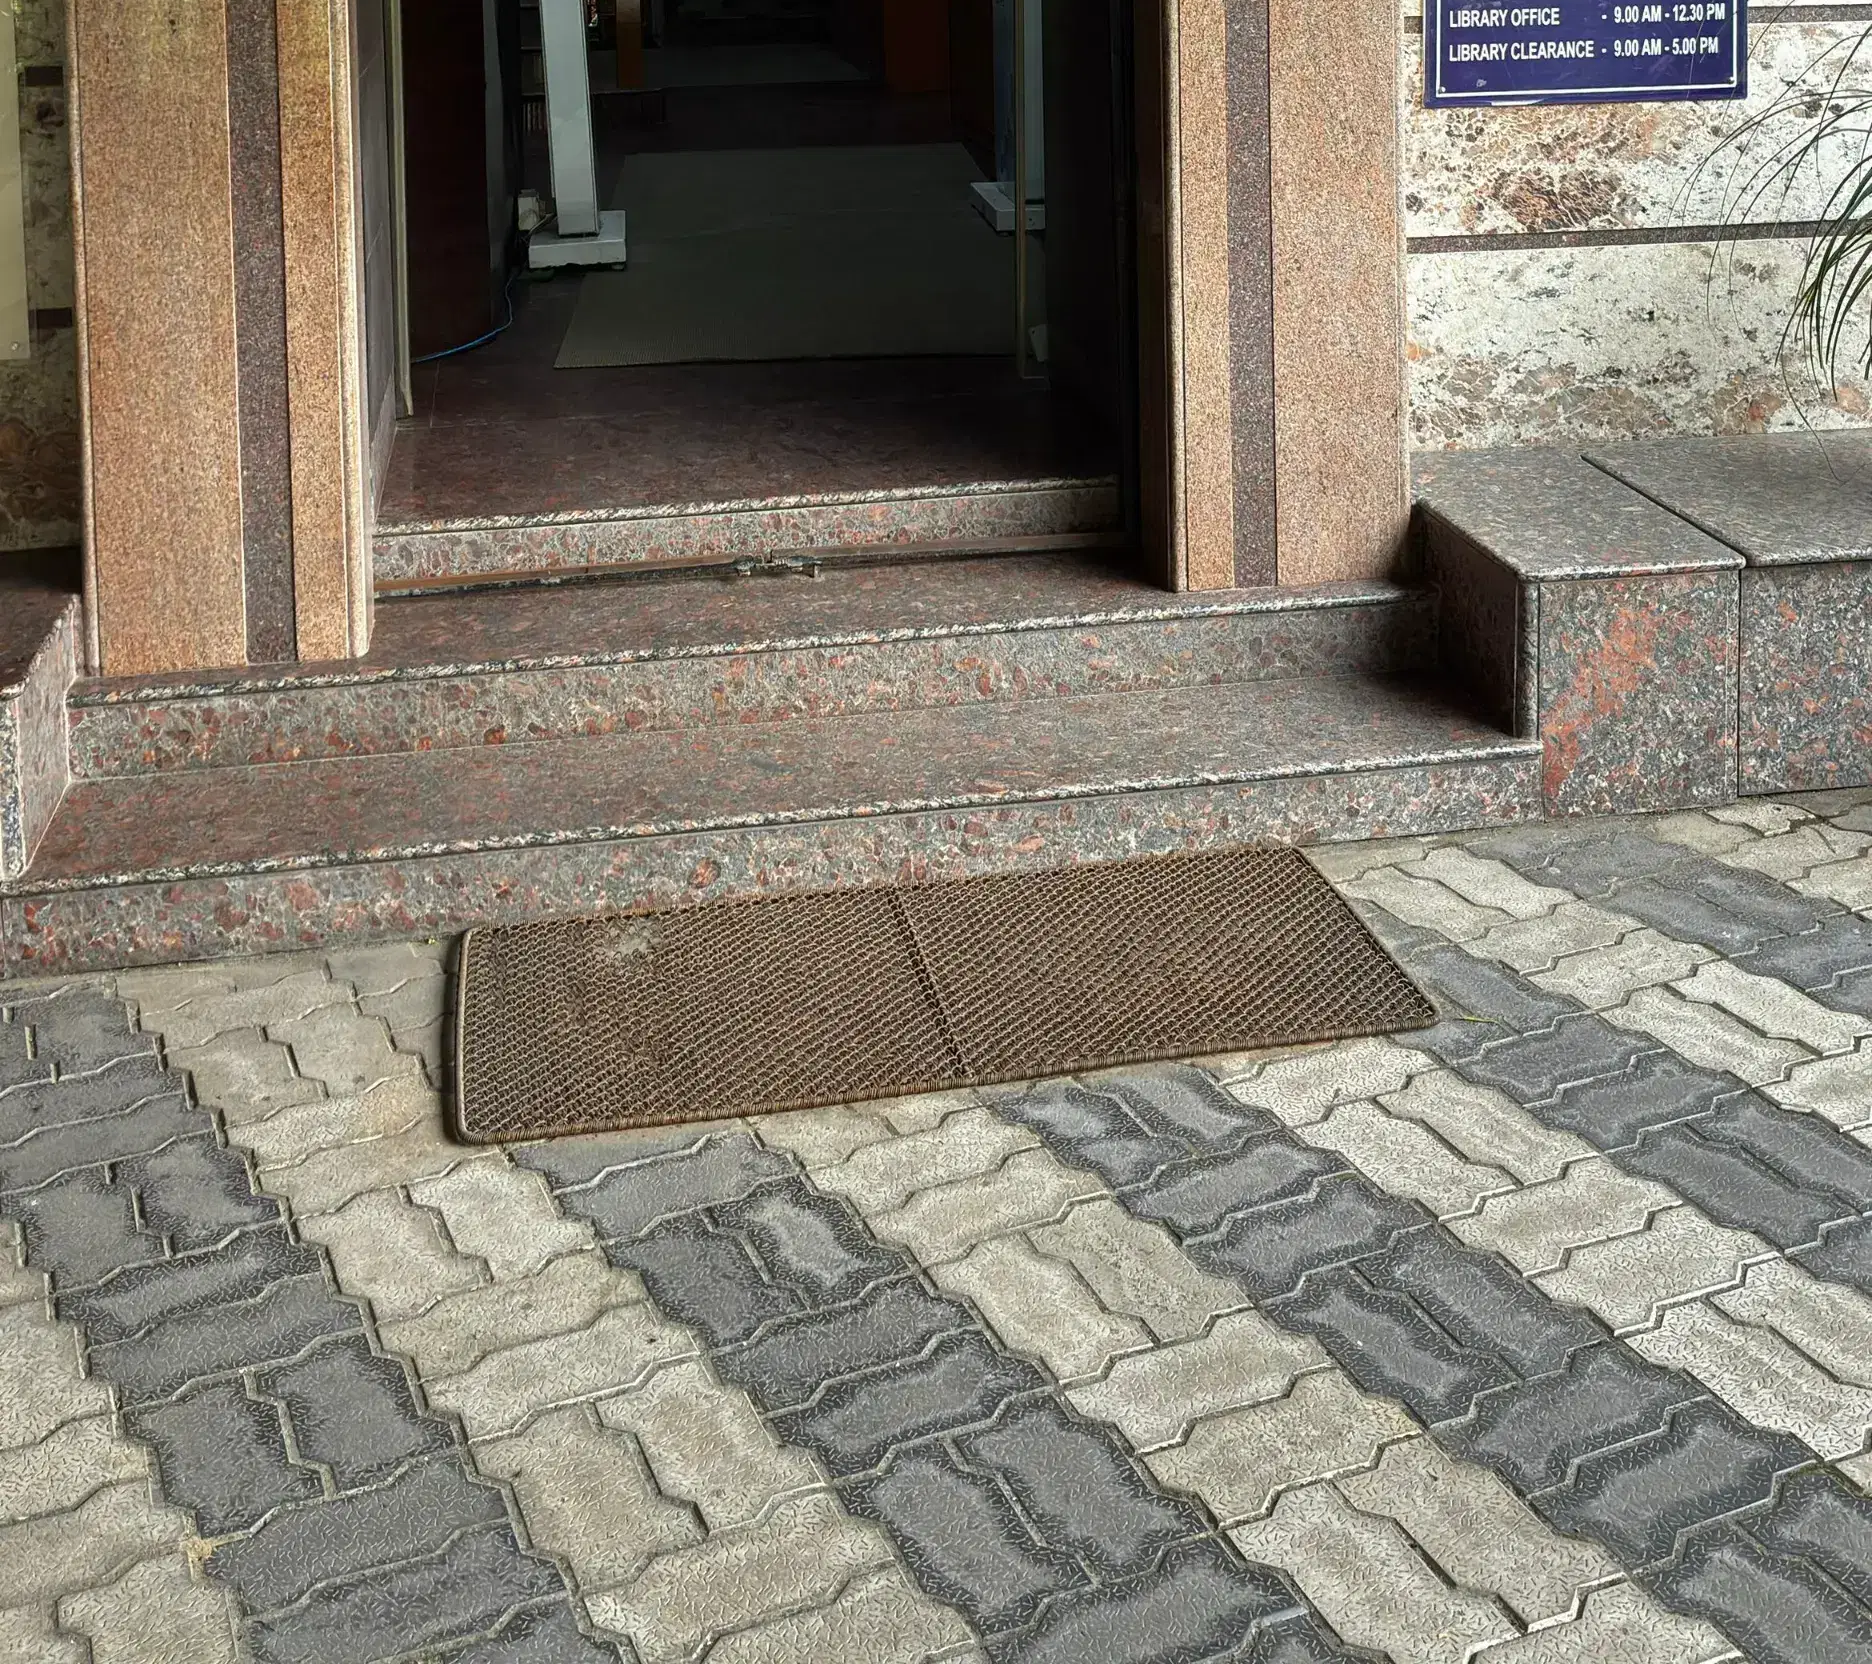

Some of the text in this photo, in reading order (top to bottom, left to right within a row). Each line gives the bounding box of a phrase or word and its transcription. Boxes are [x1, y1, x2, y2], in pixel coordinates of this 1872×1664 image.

[1449, 9, 1509, 28] LIBRARY
[1510, 7, 1560, 27] OFFICE
[1614, 5, 1640, 24] 9.00
[1641, 5, 1662, 23] AM
[1672, 3, 1704, 22] 12.30
[1706, 2, 1726, 21] PM
[1449, 42, 1509, 62] LIBRARY
[1510, 40, 1595, 60] CLEARANCE
[1613, 39, 1639, 57] 9.00
[1641, 38, 1662, 56] AM
[1672, 37, 1697, 55] 5.00
[1699, 36, 1719, 54] PM
